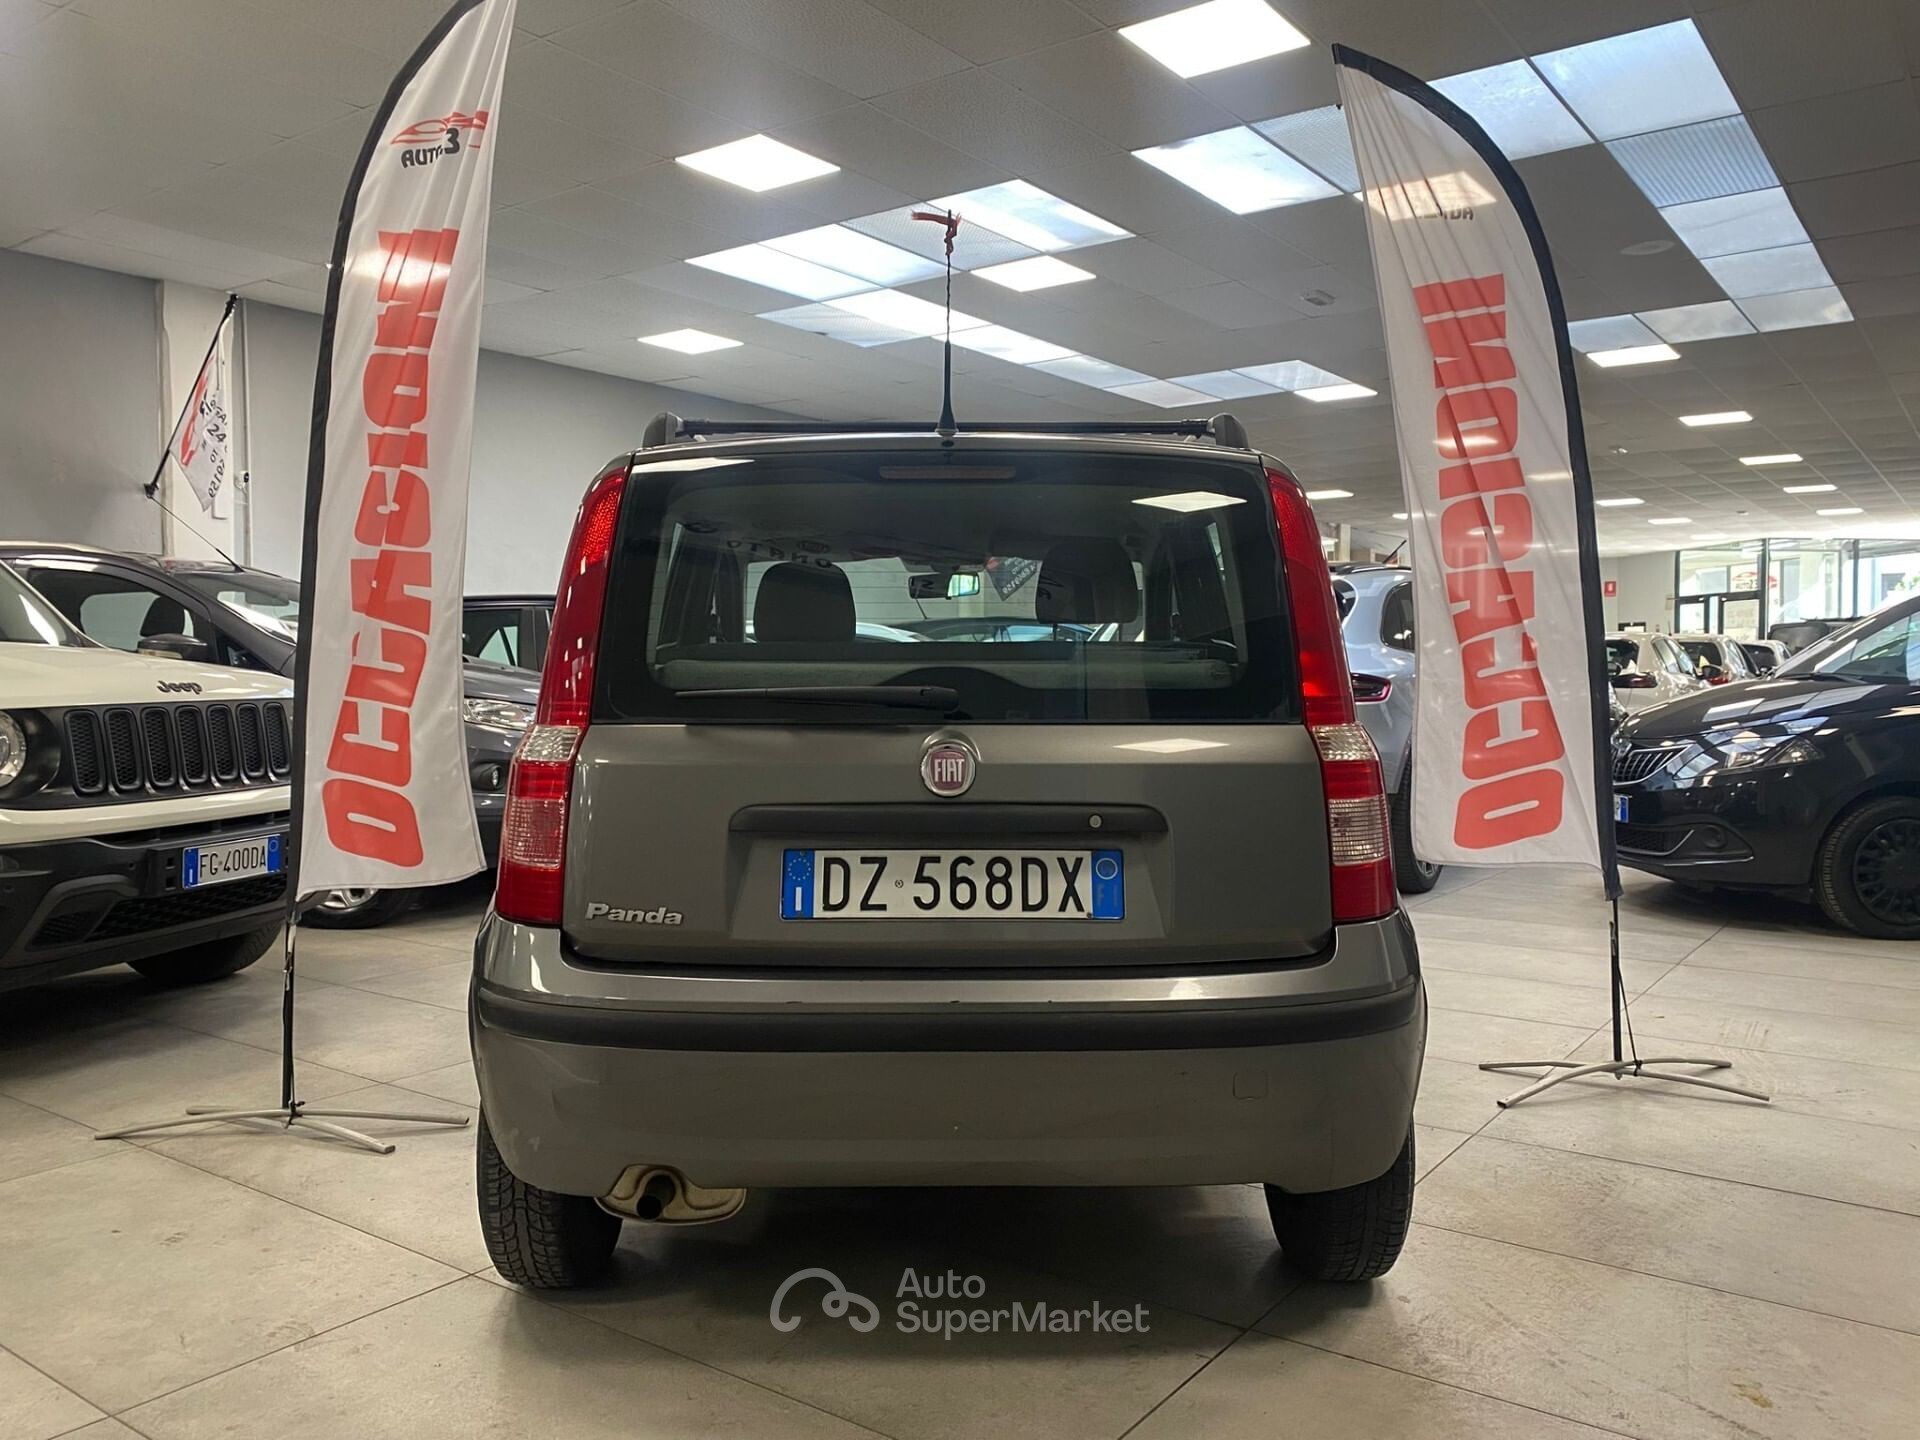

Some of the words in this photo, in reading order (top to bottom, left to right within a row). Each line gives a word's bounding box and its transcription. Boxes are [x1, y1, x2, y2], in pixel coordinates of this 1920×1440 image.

[157, 680, 202, 695] Jeep
[934, 758, 965, 782] FIAT
[822, 856, 888, 912] DZ
[913, 856, 1085, 913] 568DX
[585, 902, 682, 925] Panda
